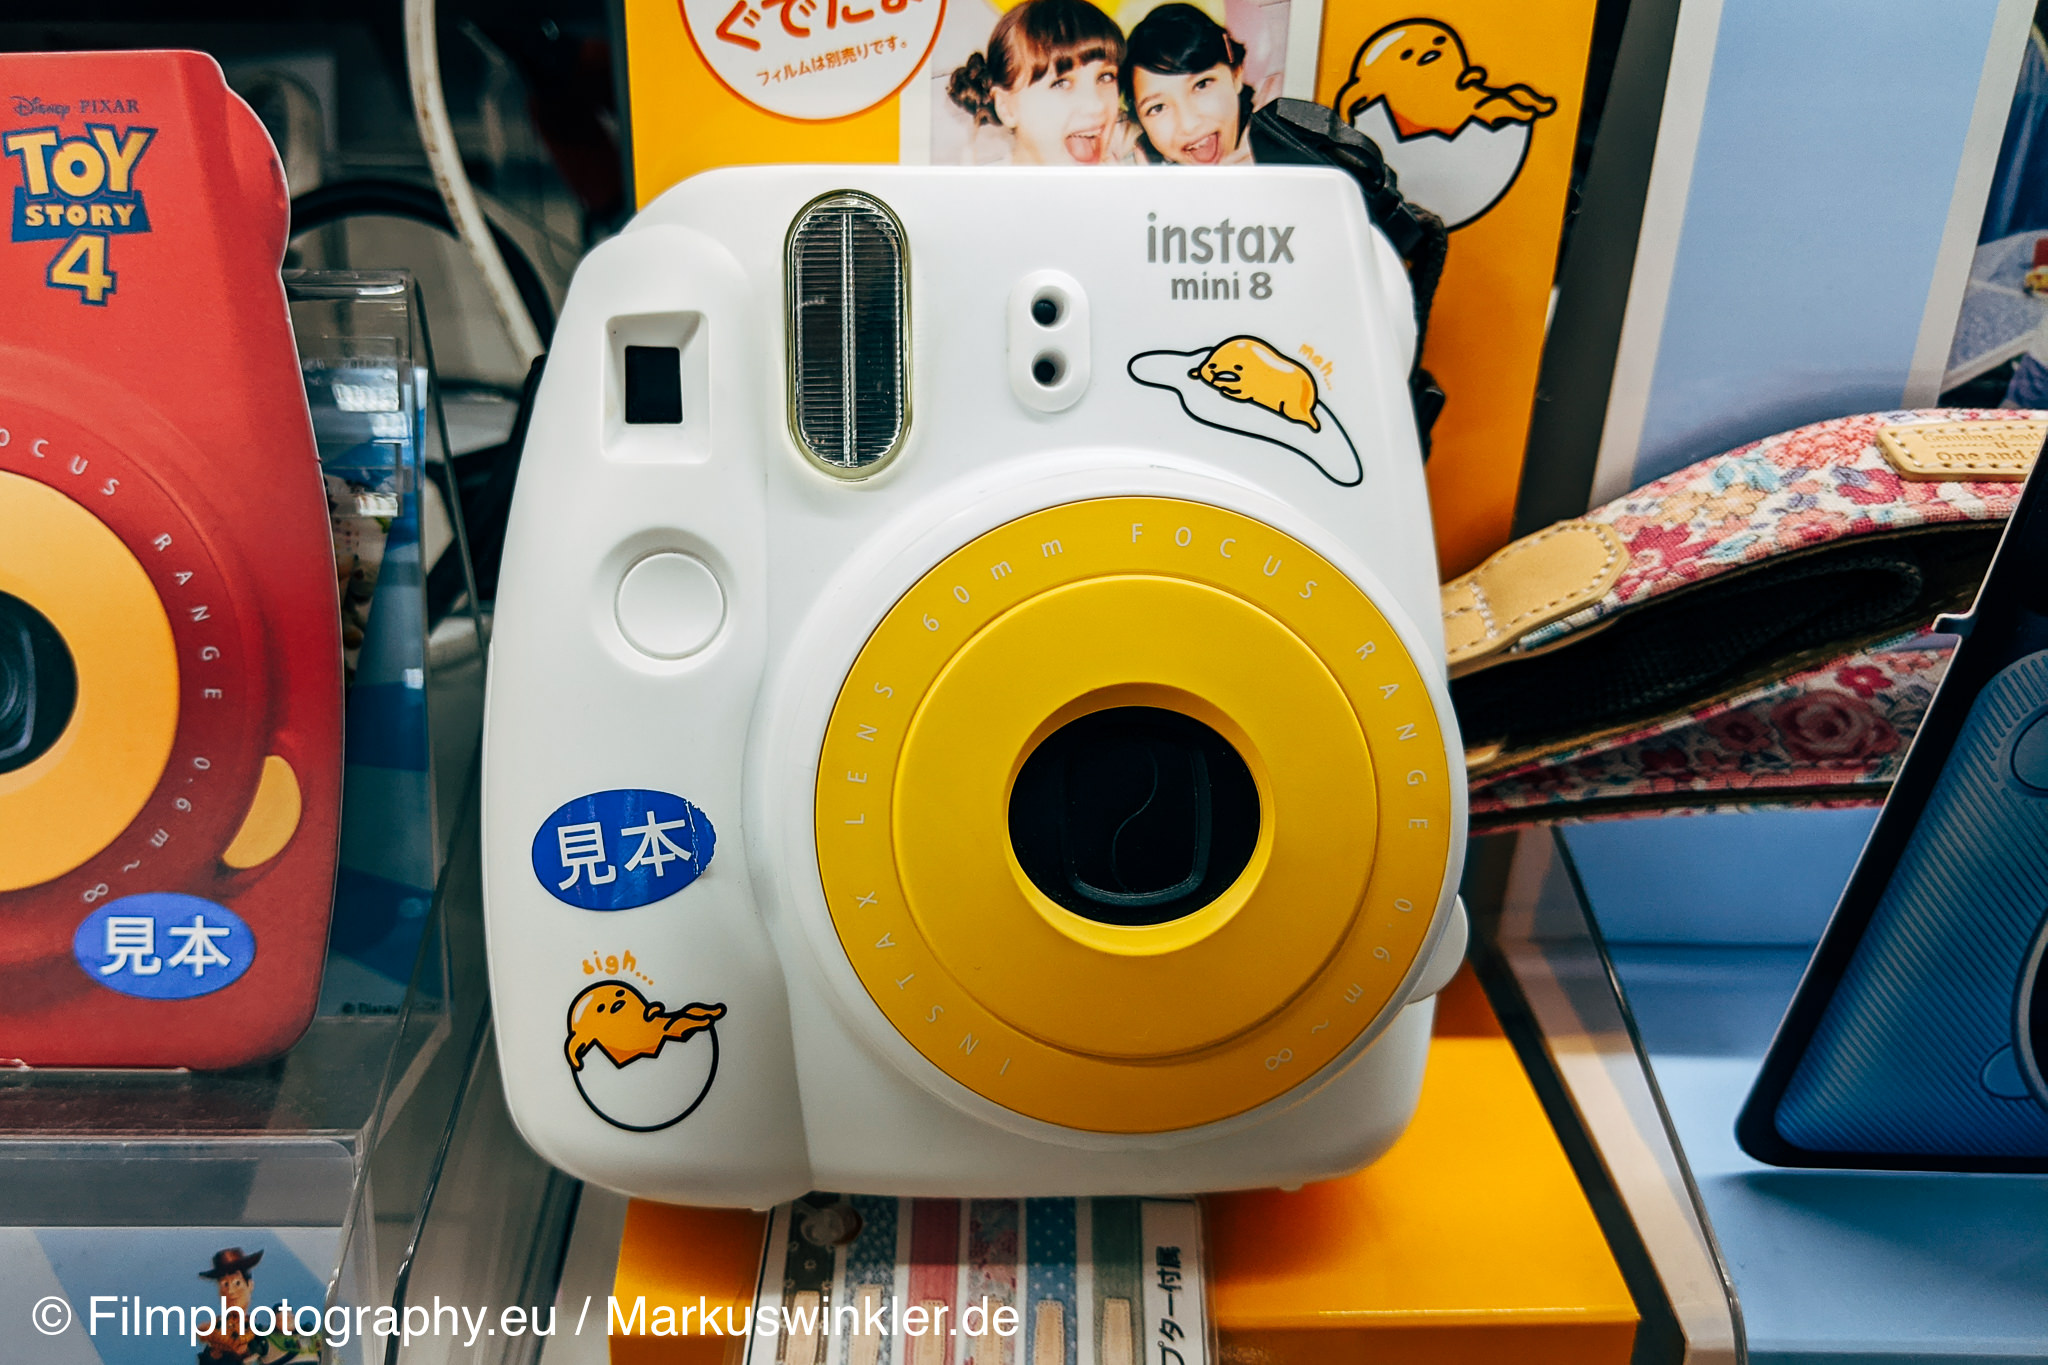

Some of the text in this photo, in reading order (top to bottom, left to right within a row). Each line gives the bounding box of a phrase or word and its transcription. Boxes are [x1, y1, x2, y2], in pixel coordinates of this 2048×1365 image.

[716, 0, 922, 51] ぐでた
[9, 96, 140, 120] Disney PIXAR
[25, 204, 137, 227] STORY
[1146, 212, 1296, 264] instax
[49, 232, 115, 304] 4
[1171, 271, 1273, 300] mini 8
[1936, 451, 1979, 461] One
[1985, 449, 2028, 461] and
[1132, 523, 1318, 599] FOCUS
[154, 533, 221, 699] RANGE
[845, 682, 893, 824] LENS
[1356, 640, 1428, 828] RANGE
[557, 810, 692, 891] 見本
[100, 915, 232, 977] 見本
[856, 891, 1011, 1076] INSTAX
